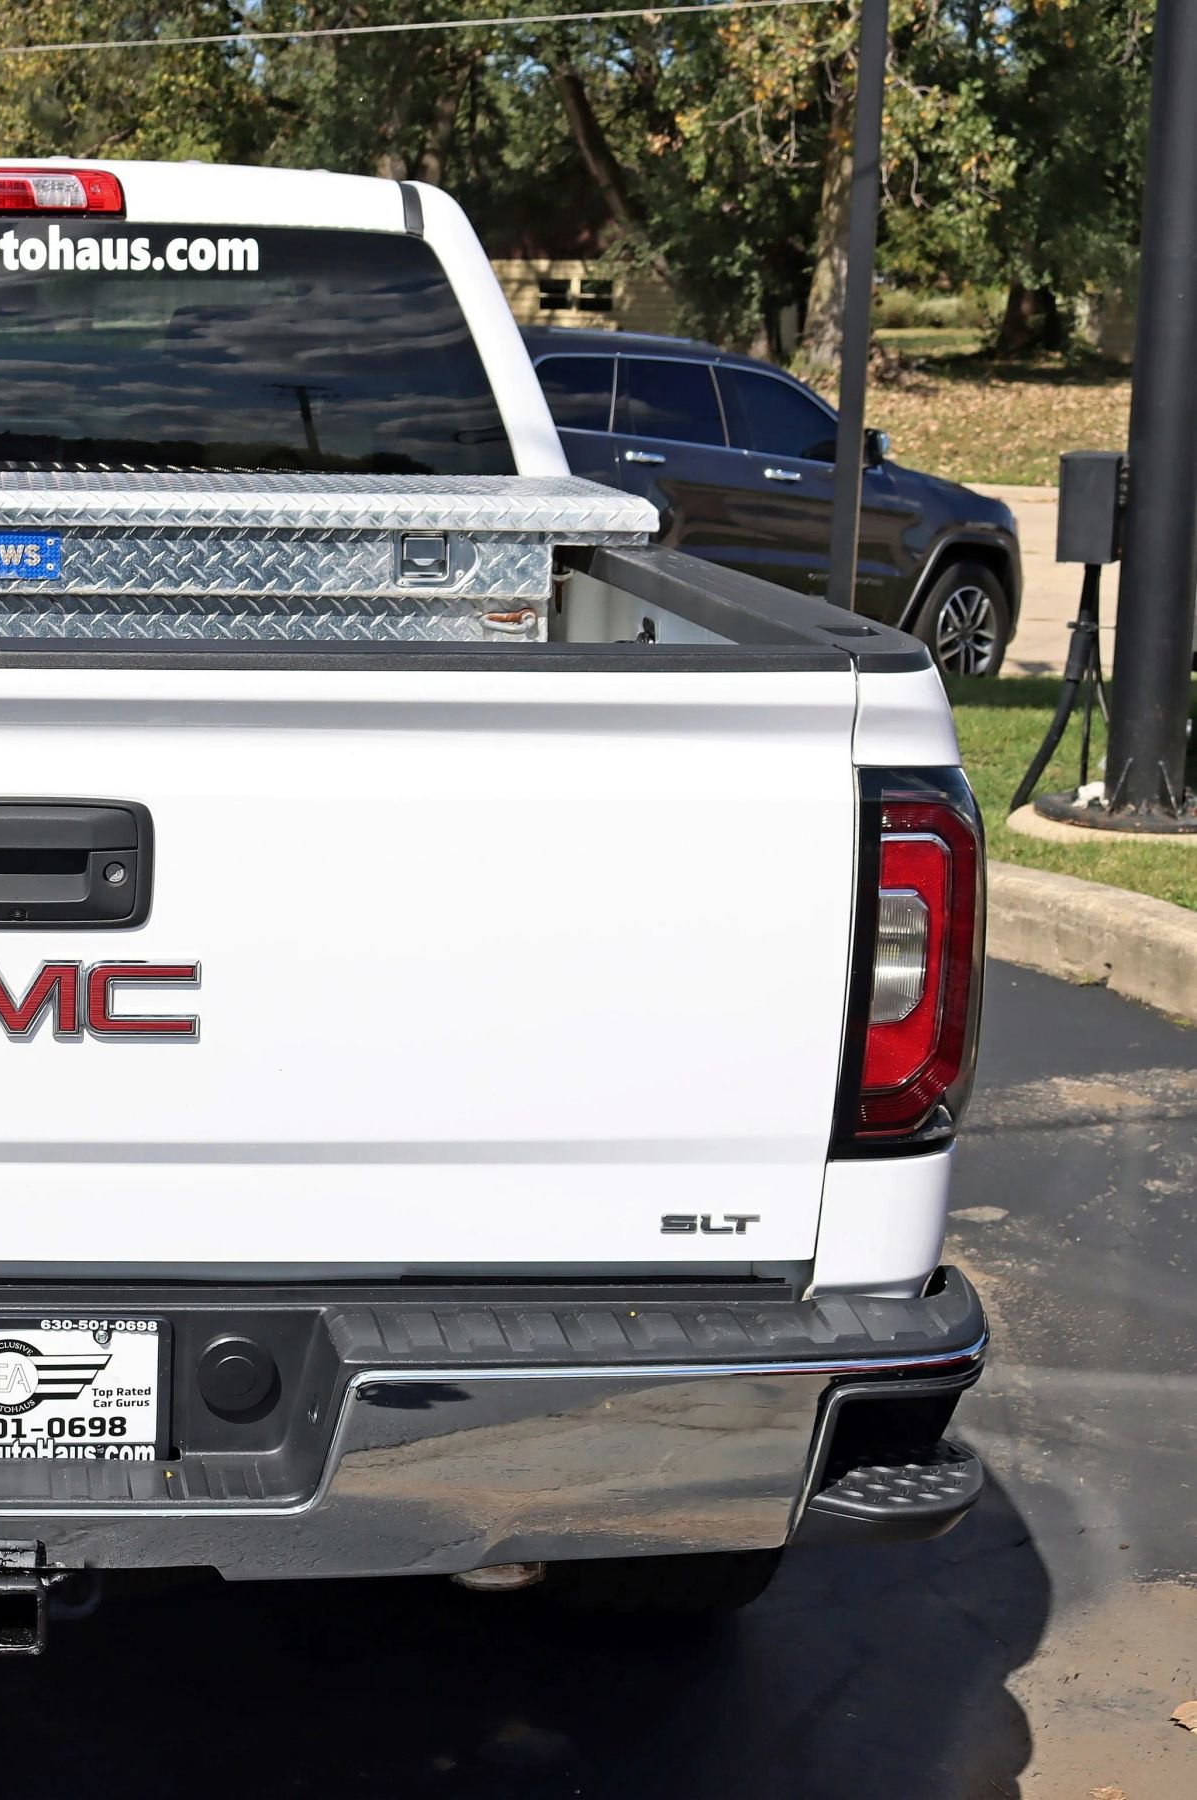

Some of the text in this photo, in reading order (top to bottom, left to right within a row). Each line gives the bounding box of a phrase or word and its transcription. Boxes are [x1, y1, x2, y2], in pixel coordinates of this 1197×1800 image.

[660, 1213, 761, 1234] SLT
[40, 1320, 158, 1331] 630-501-0698
[92, 1387, 151, 1398] Top Rated
[93, 1399, 150, 1407] Car Gurus
